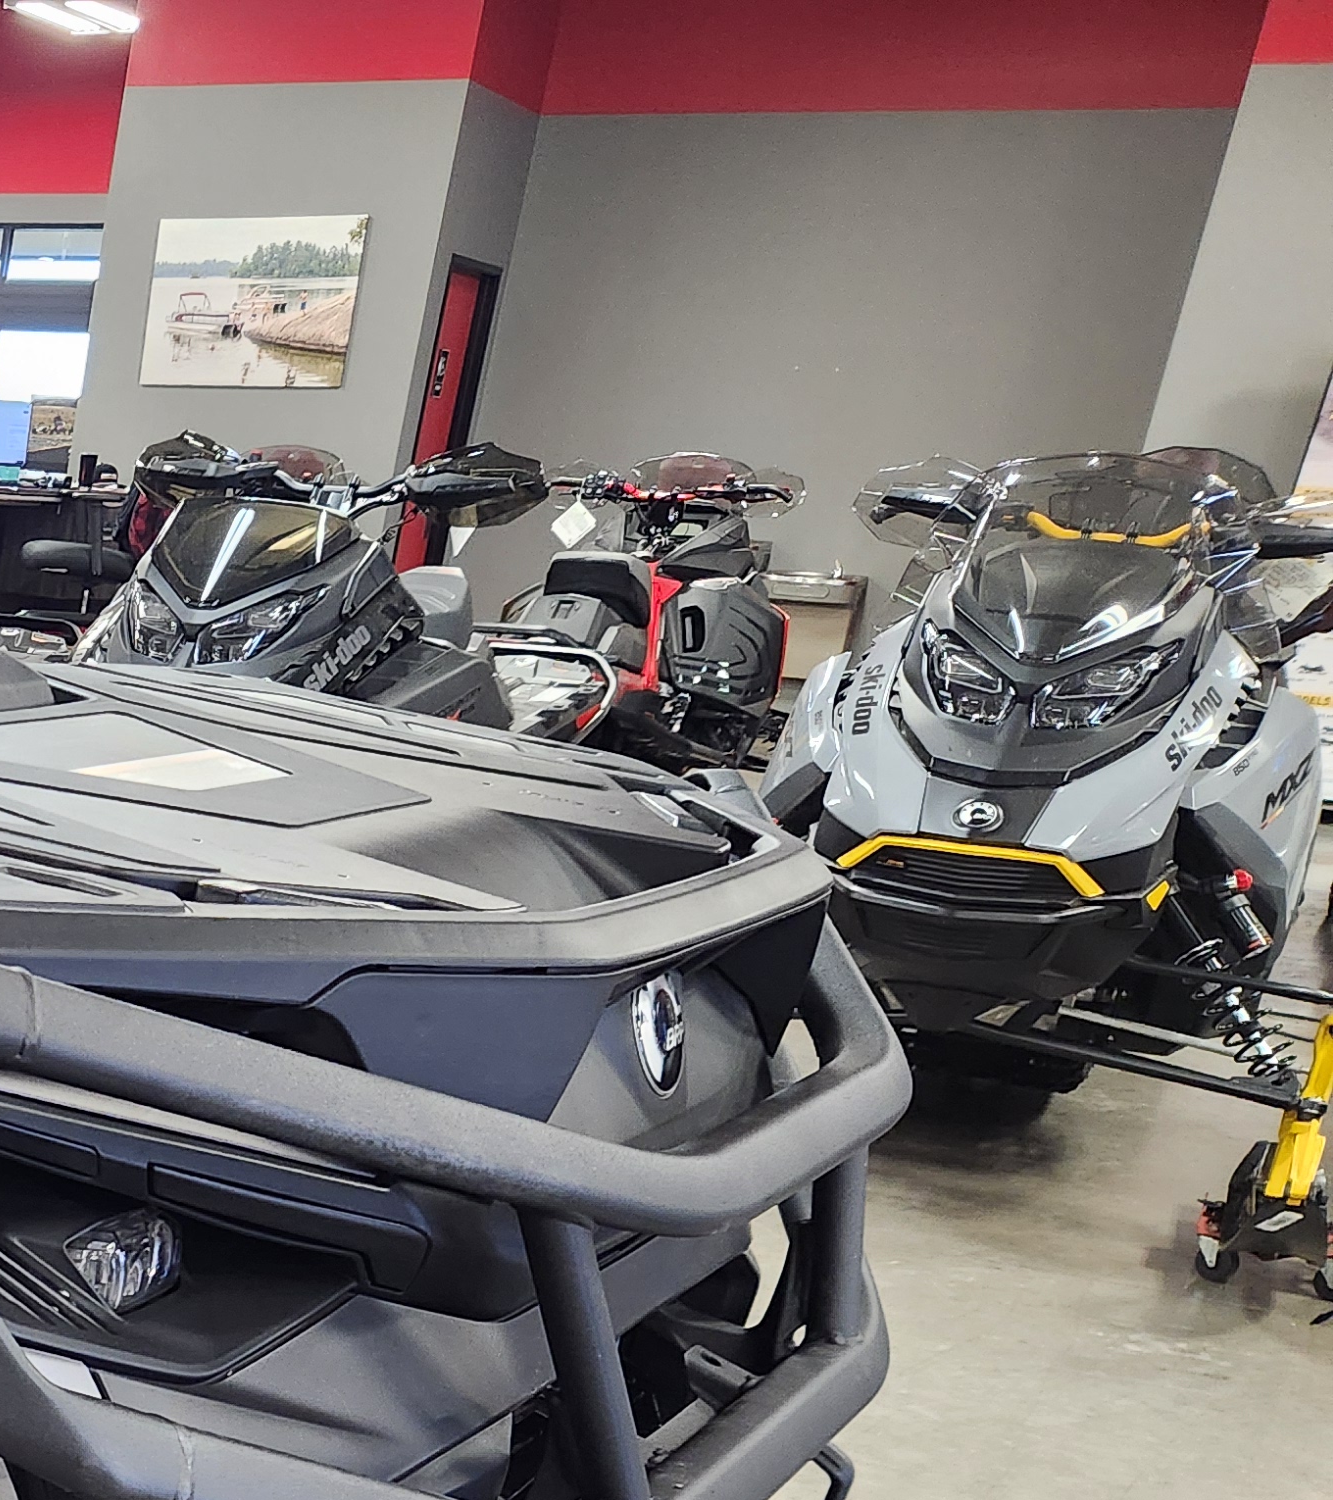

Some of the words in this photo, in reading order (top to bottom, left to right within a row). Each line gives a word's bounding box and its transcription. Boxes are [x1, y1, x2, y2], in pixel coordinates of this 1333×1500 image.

[303, 625, 372, 692] ski-doo
[852, 664, 886, 735] ski-doo
[1233, 758, 1250, 777] 850
